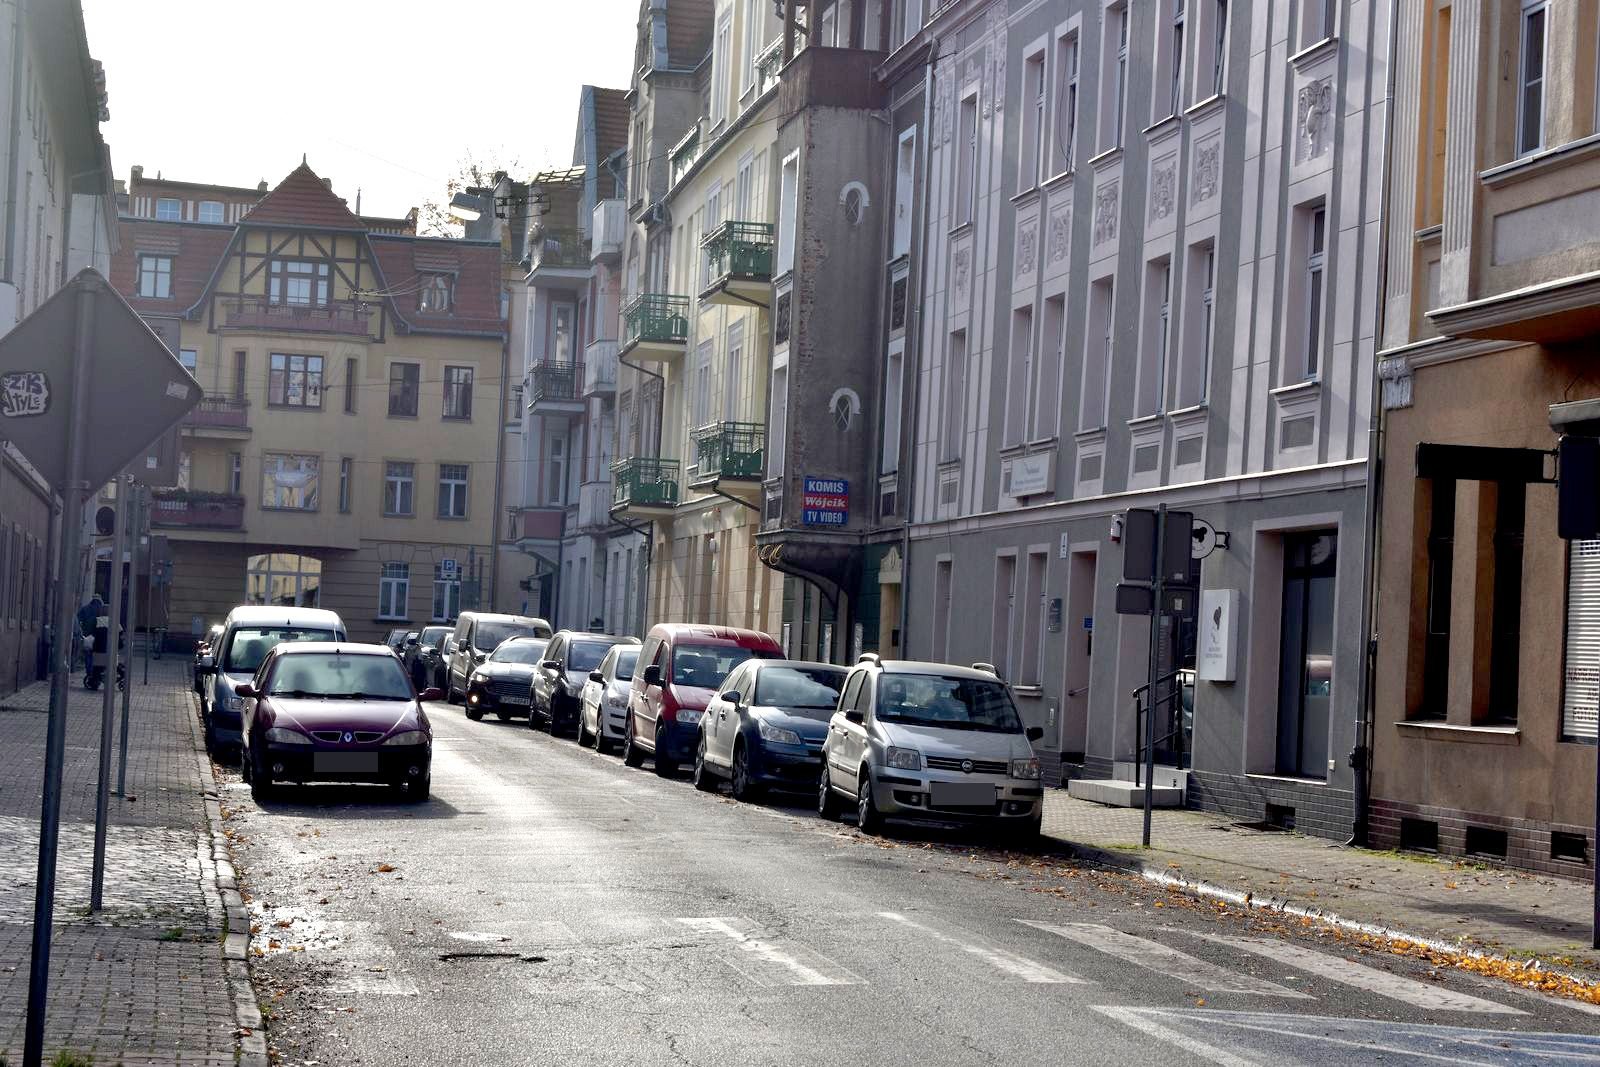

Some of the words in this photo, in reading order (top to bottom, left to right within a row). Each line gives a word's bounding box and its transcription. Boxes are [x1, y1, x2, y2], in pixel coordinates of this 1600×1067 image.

[808, 480, 844, 493] KOMIS
[805, 496, 846, 508] Wójcik
[807, 511, 818, 522] TV
[820, 511, 842, 523] VIDEO
